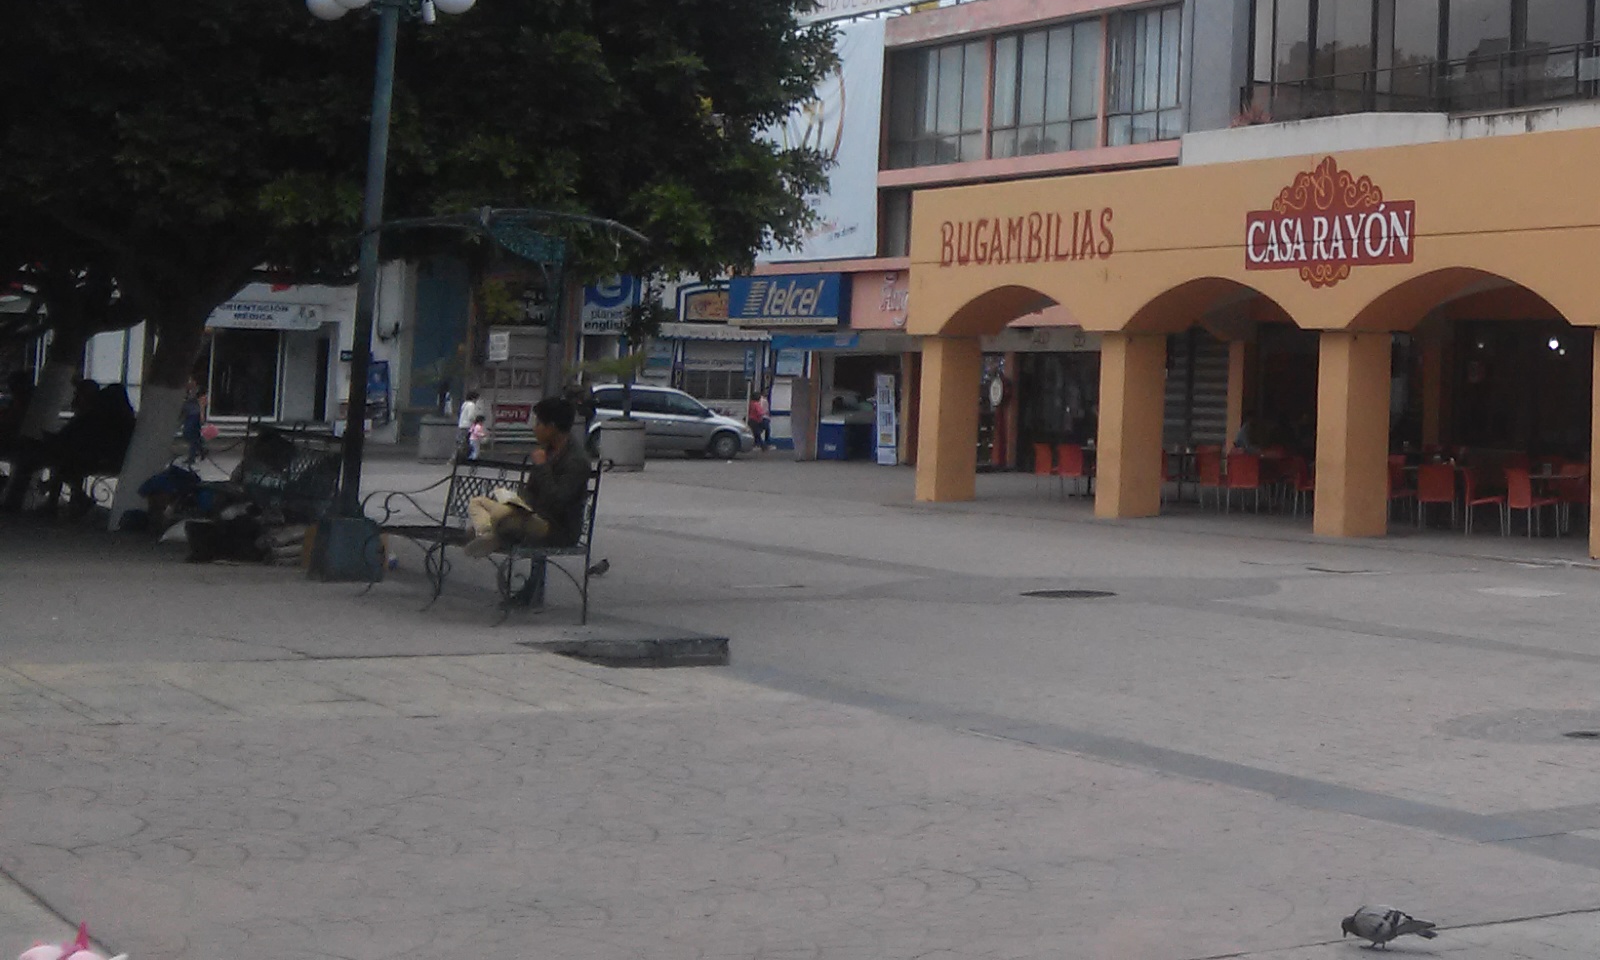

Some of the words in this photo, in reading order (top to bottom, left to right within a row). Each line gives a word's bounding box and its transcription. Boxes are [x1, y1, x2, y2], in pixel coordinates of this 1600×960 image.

[940, 207, 1115, 268] BUGAMBILIAS
[1247, 217, 1307, 263] CASA
[1312, 203, 1412, 261] RAYÓN
[763, 279, 826, 316] telcel
[584, 321, 627, 331] english
